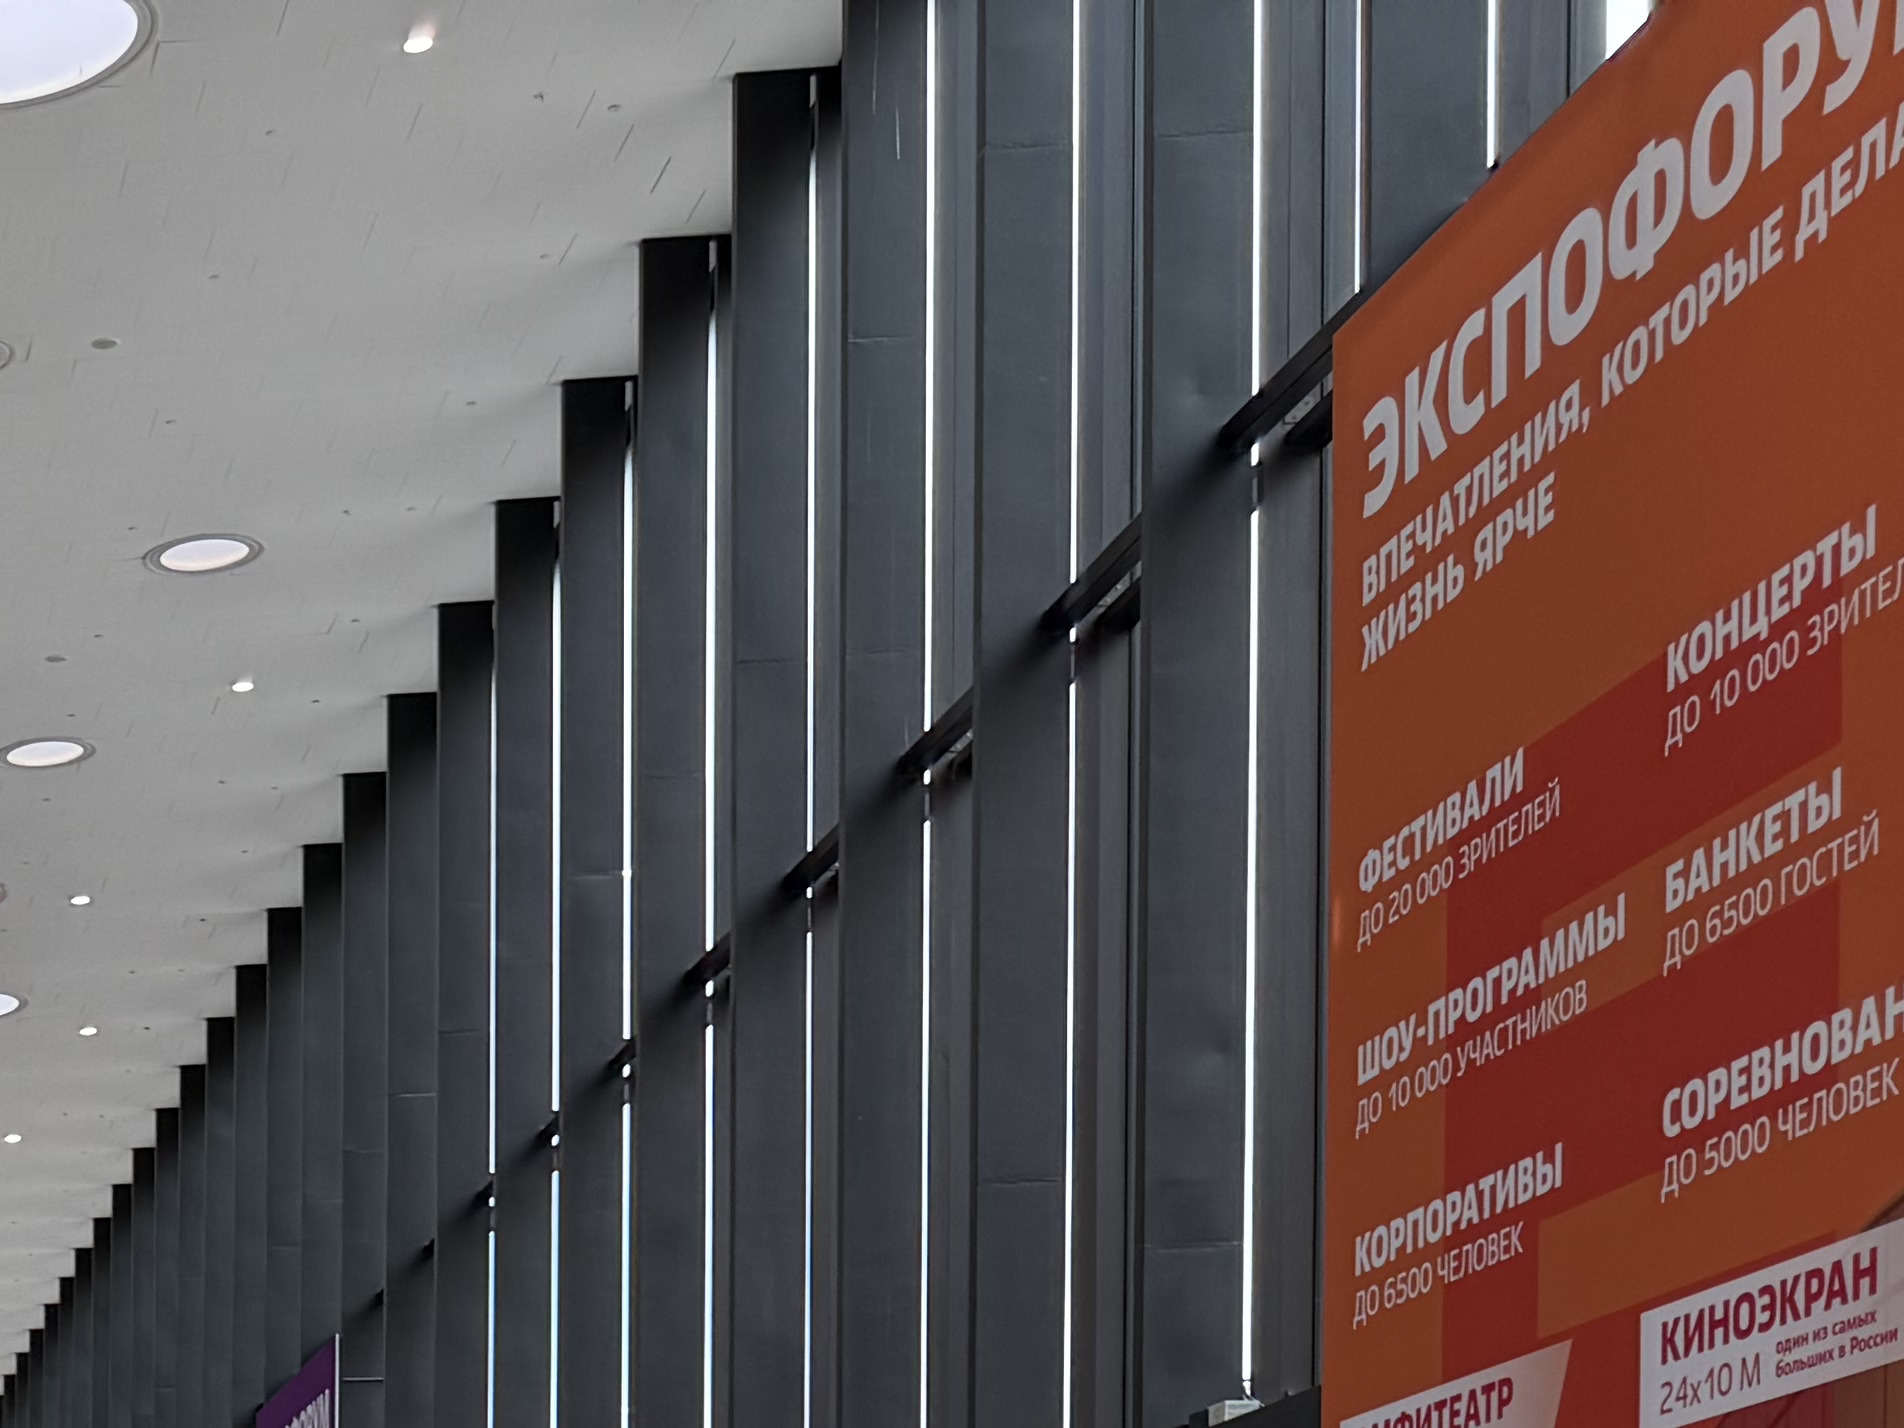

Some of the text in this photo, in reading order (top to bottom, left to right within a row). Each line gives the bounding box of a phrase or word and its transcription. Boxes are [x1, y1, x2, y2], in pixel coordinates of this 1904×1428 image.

[1363, 0, 1904, 518] ЭКСПОФОРУ
[1362, 378, 1591, 606] ВПЕЧАТЛЕНИЯ,
[1601, 204, 1785, 409] КОТОРЫЕ
[1361, 471, 1555, 672] ЖИЗНЬ ЯРЧЕ
[1667, 504, 1876, 692] КОНЦЕРТЫ
[1664, 695, 1700, 757] ДО
[1710, 668, 1740, 714] 10
[1747, 630, 1799, 692] 000
[1356, 776, 1561, 952] ДО 20 000 ЗРИТЕЛЕЙ
[1358, 747, 1524, 893] ФЕСТИВАЛИ
[1663, 809, 1880, 977] ДО 6500 ГОСТЕЙ
[1665, 766, 1842, 913] БАНКЕТЫ
[1355, 978, 1587, 1139] ДО 10 000 УЧАСТНИКОВ
[1357, 892, 1625, 1085] ШОУ-ПРОГРАММЫ
[1661, 1058, 1900, 1202] ДО 5000 ЧЕЛОВЕК
[1353, 1222, 1524, 1329] ДО 6500 ЧЕЛОВЕК
[1355, 1143, 1562, 1276] КОРПОРАТИВЫ
[1661, 1246, 1878, 1366] КИНОЭКРАН
[1740, 1353, 1761, 1391] М
[1775, 1327, 1899, 1378] больших в России
[1776, 1310, 1878, 1356] один из самых
